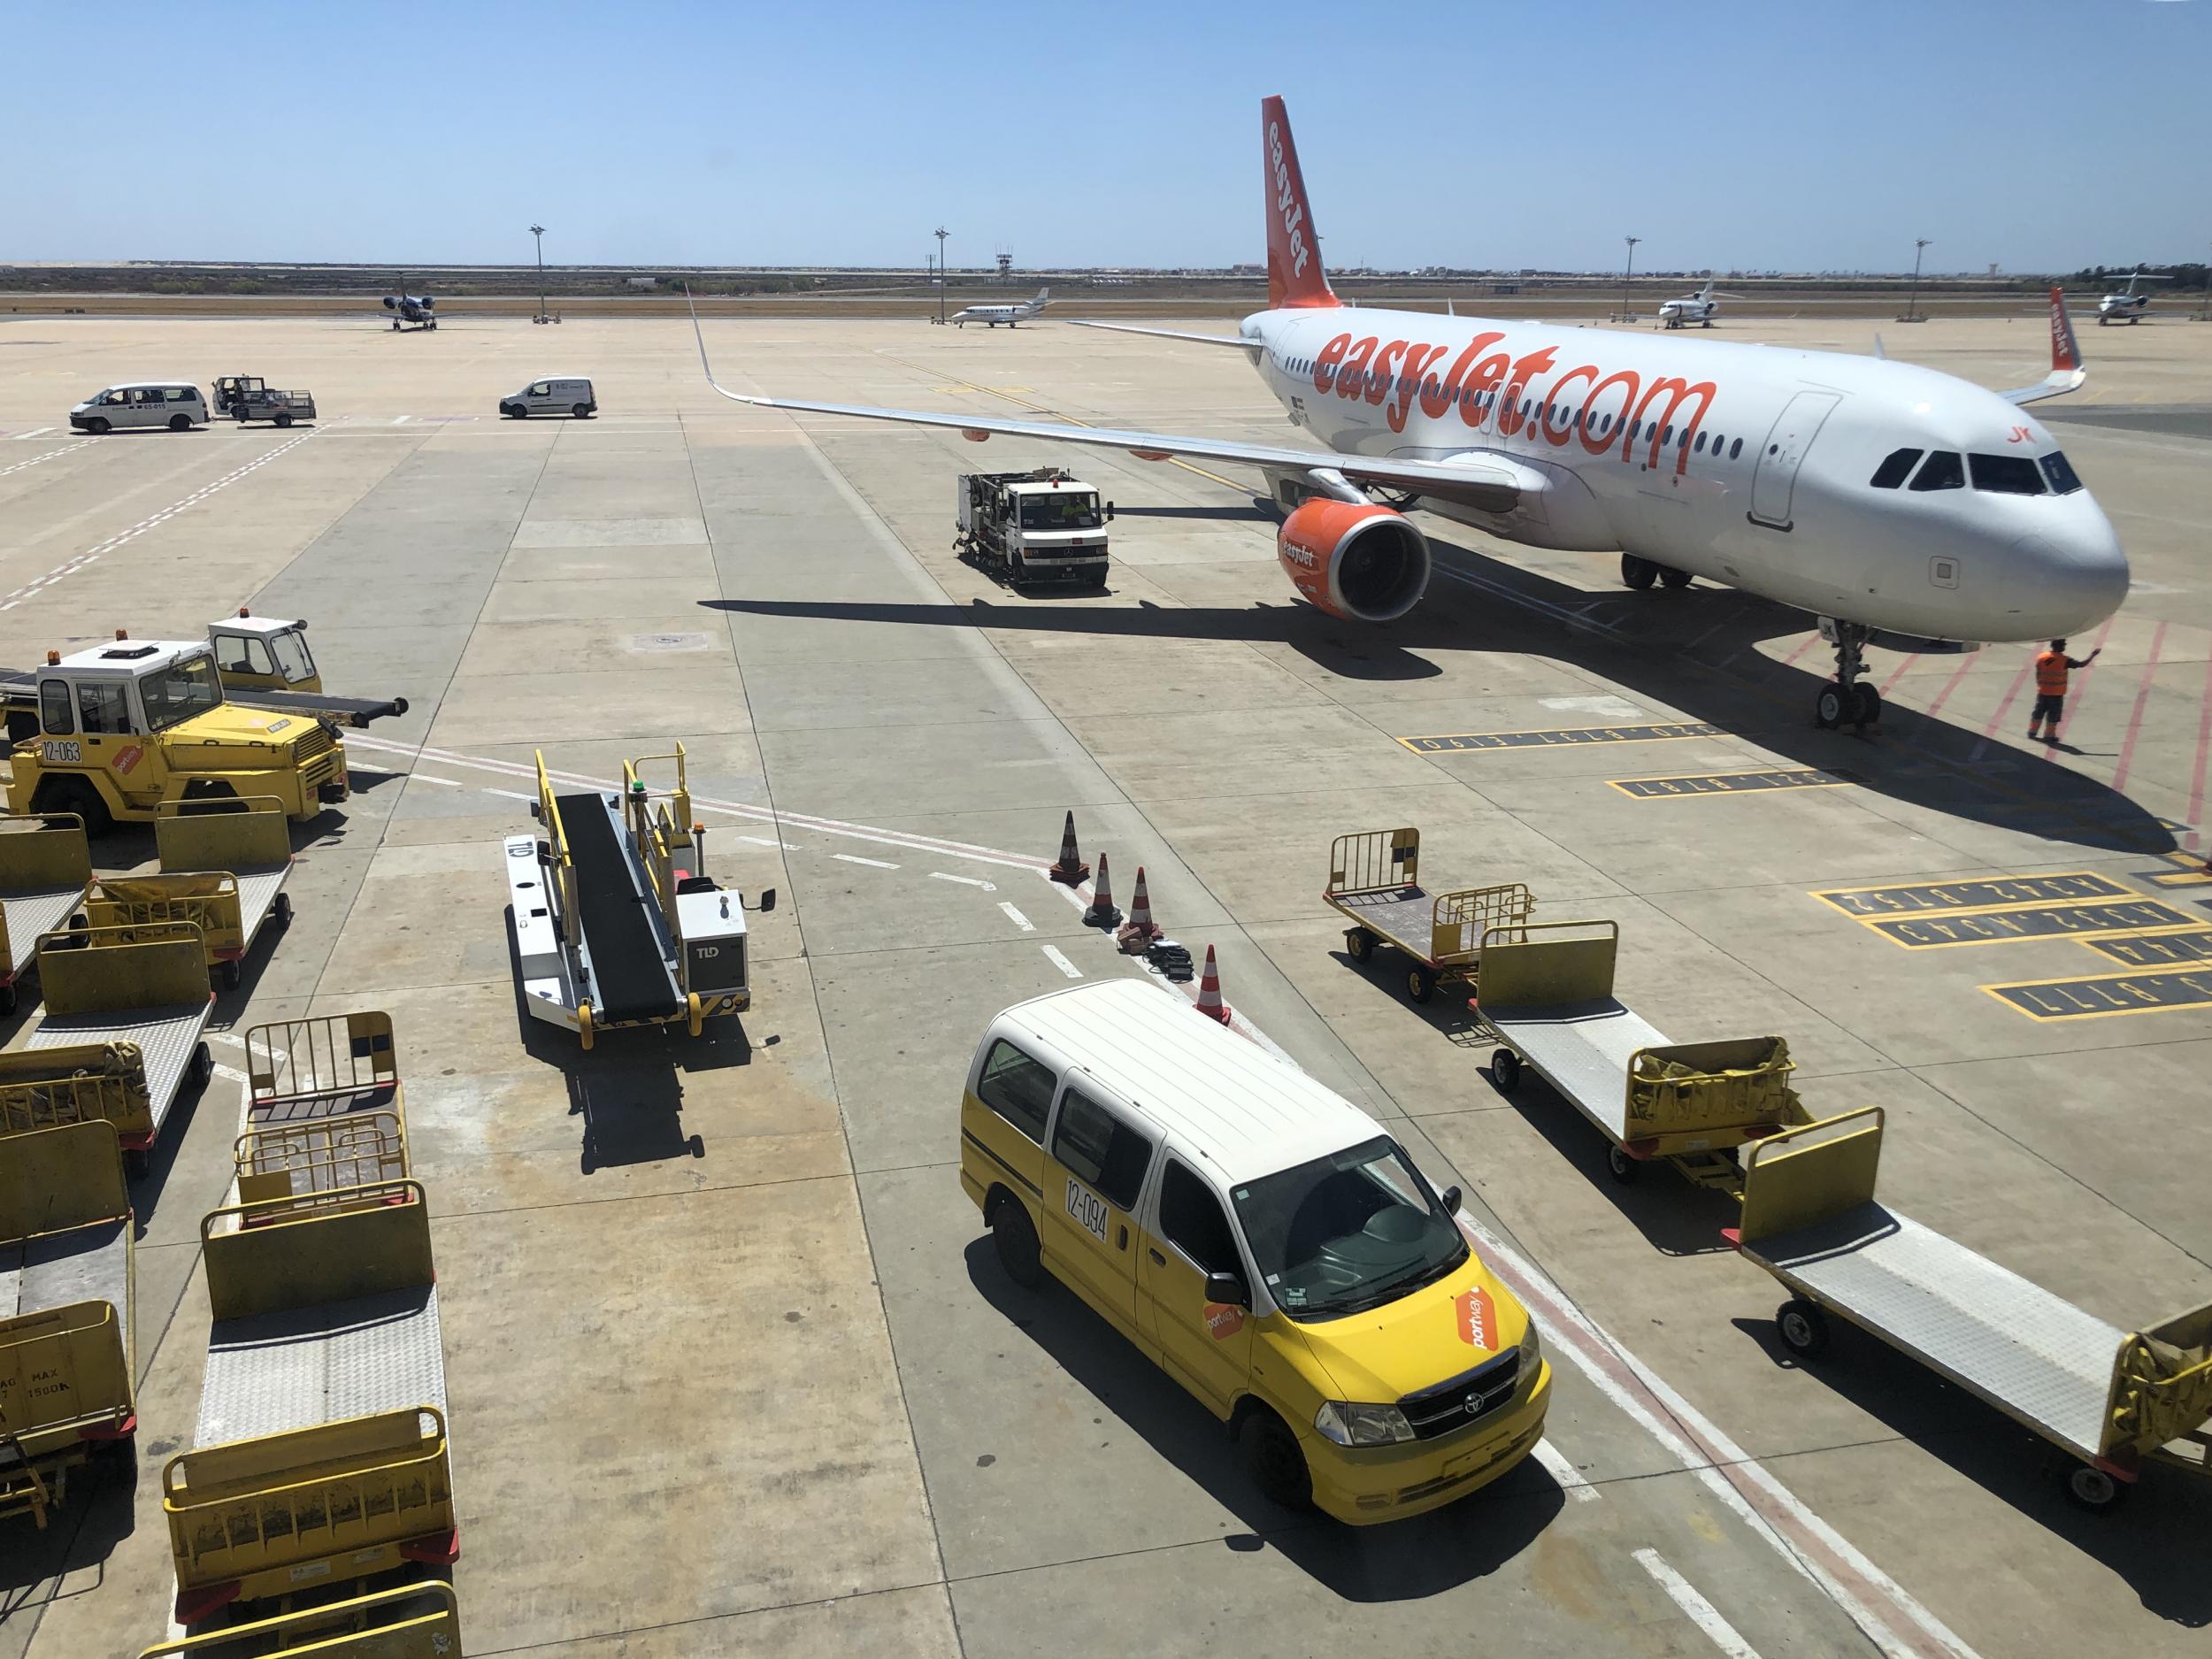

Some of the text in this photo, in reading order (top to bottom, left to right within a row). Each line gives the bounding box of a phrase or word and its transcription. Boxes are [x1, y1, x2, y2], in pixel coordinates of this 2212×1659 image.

[1269, 121, 1310, 279] easyJet
[2051, 303, 2069, 357] easyJet
[1314, 332, 1717, 475] easyJet.com
[2007, 426, 2036, 444] JK
[1284, 541, 1315, 567] easyJet
[42, 741, 81, 762] 12-063
[117, 749, 139, 772] portway
[507, 841, 534, 857] TLD
[695, 946, 719, 959] TLD
[1068, 1179, 1107, 1240] 12-094
[1469, 1294, 1487, 1349] portway
[32, 1368, 58, 1382] MAX
